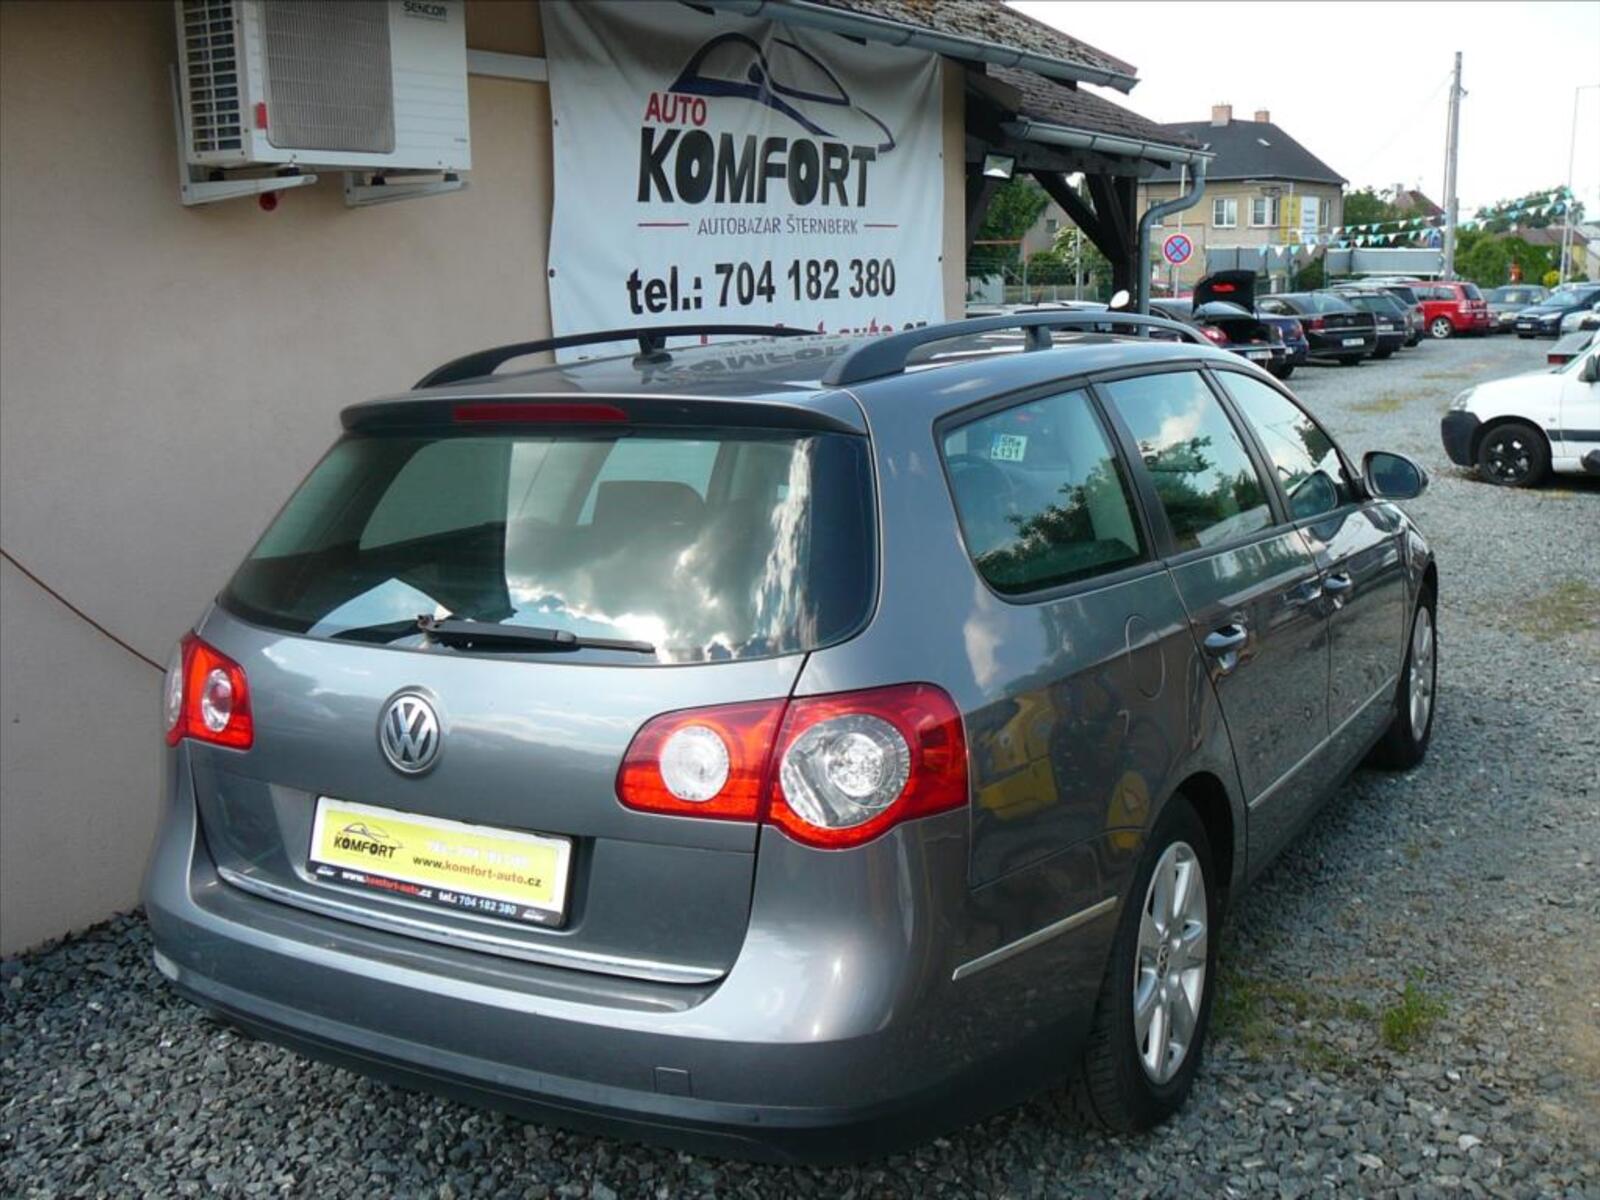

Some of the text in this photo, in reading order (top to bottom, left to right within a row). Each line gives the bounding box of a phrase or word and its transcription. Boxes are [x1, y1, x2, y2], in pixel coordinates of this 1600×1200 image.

[403, 0, 447, 17] SENCOR
[644, 92, 707, 126] AUTO
[637, 127, 878, 207] KOMFORT
[698, 214, 858, 236] AUTOBAZAR ŠTERNBERK
[626, 258, 896, 315] tel.: 704 182 380
[333, 835, 396, 859] KOMFORT
[412, 856, 542, 887] www.komfort-auto.cz
